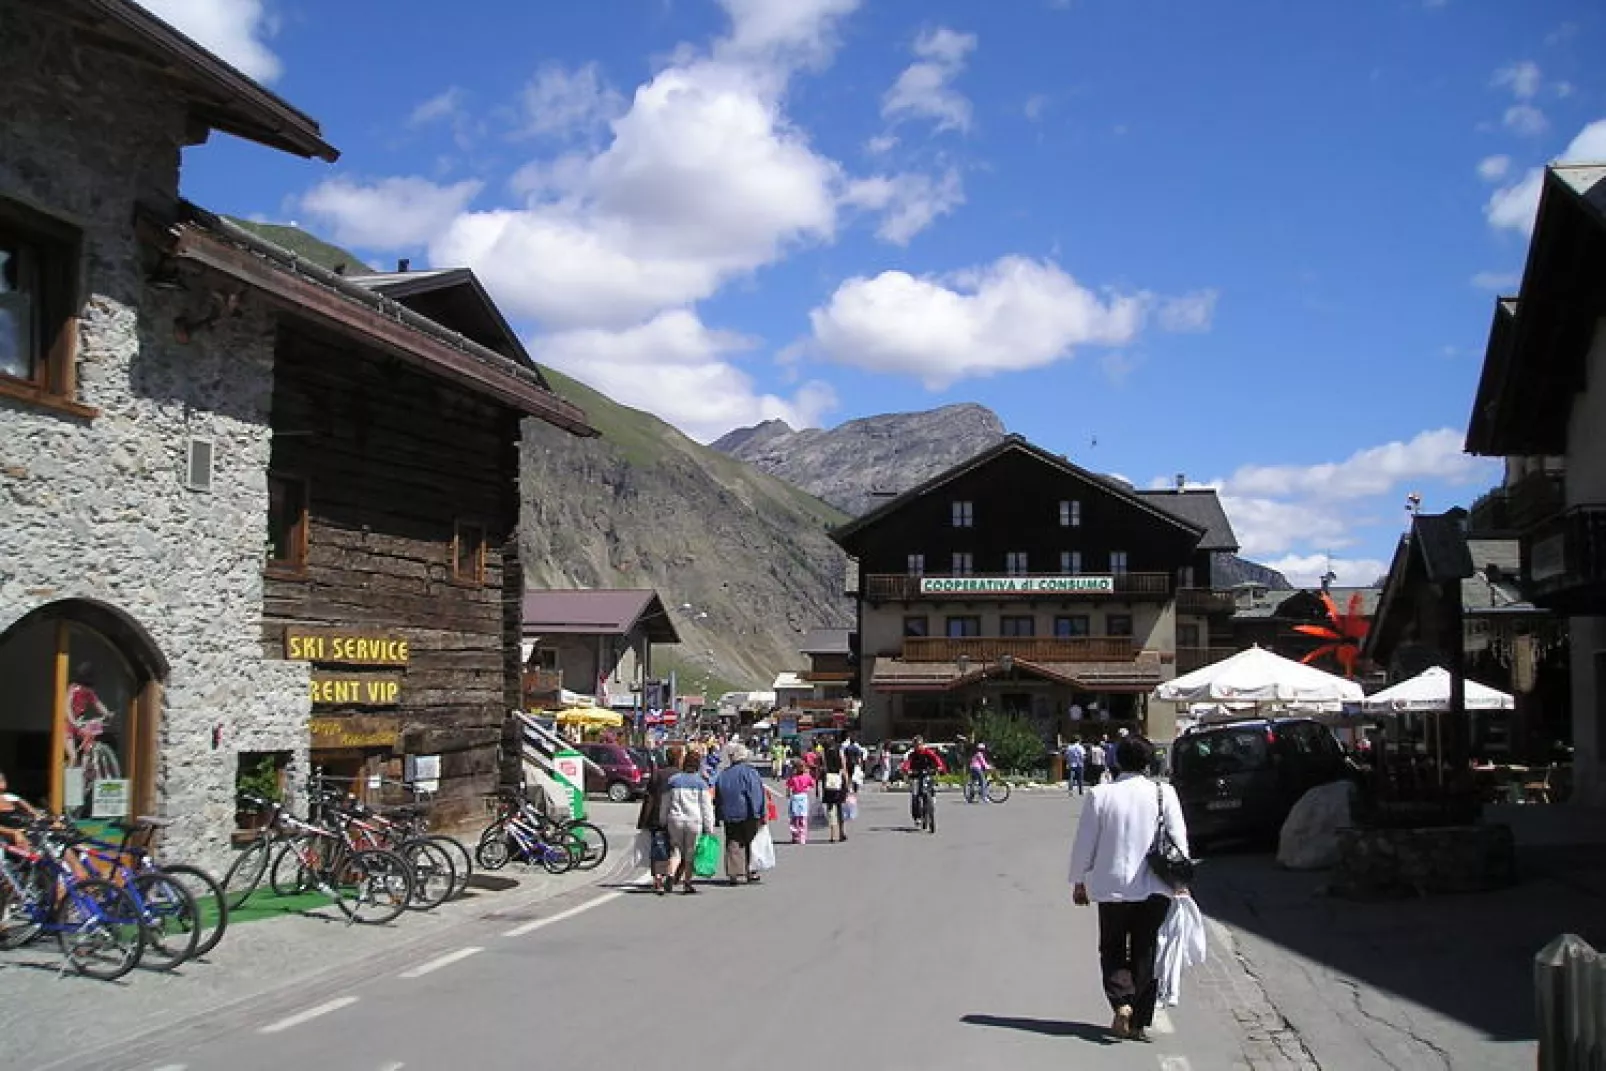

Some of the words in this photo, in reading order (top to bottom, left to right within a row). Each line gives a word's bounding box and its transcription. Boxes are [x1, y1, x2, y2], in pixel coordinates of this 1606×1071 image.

[924, 579, 1016, 592] COOPERATIVA
[1021, 579, 1032, 591] di
[1039, 579, 1110, 591] CONSUMO
[289, 637, 324, 658] SKI
[332, 637, 408, 660] SERVICE
[310, 680, 360, 702] RENT
[367, 681, 399, 702] VIP
